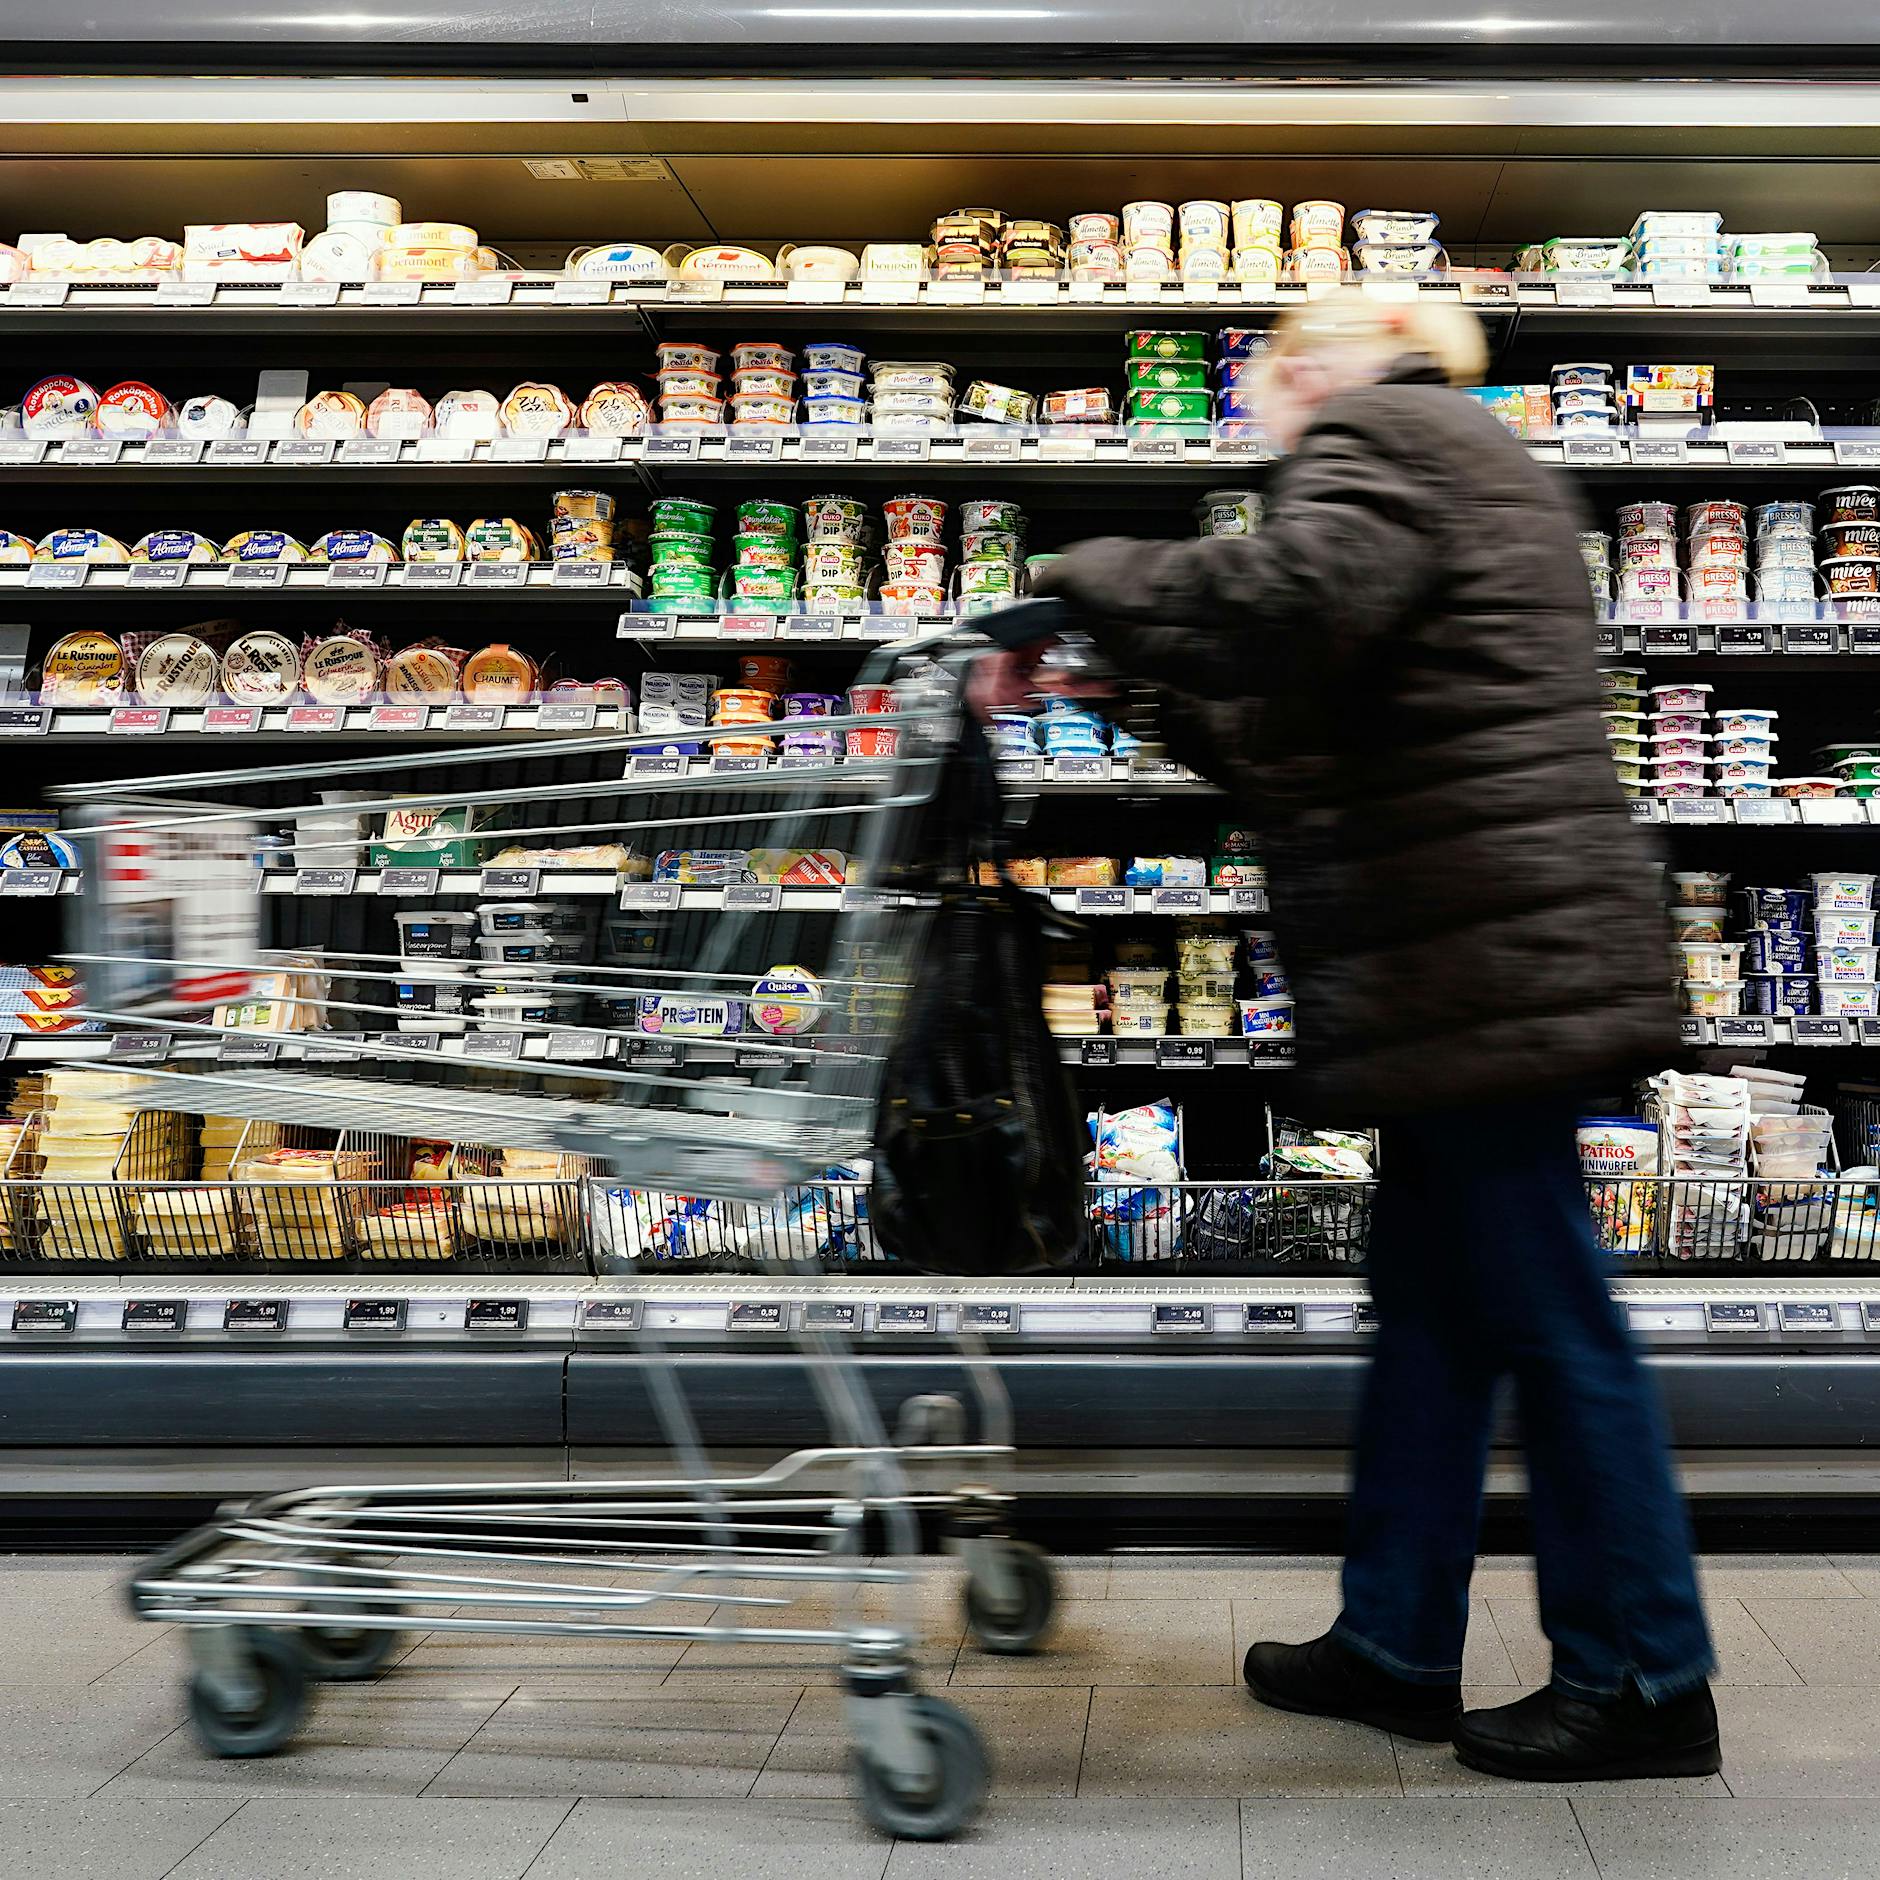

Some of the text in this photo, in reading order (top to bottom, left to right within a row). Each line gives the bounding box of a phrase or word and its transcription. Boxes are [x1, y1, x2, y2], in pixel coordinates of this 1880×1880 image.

[1384, 220, 1415, 231] Brunch
[1382, 249, 1414, 260] Brunch
[871, 259, 918, 271] boursin
[27, 379, 74, 413] Rotkäppchen
[107, 386, 158, 415] Rotkäppchen
[1835, 492, 1877, 508] miree
[1709, 511, 1740, 521] BRESSO
[1769, 511, 1800, 520] BRESSO
[823, 527, 840, 535] DIP
[912, 527, 930, 535] DIP
[55, 538, 97, 555] Almzeit
[151, 540, 192, 556] Almzeit
[242, 540, 282, 556] Almzeit
[330, 540, 370, 556] Almzeit
[1628, 543, 1659, 553] BRESSO
[1711, 542, 1741, 551] BRESSO
[1780, 542, 1809, 552] BRESSO
[821, 569, 838, 577] DIP
[890, 571, 903, 580] DIP
[1830, 563, 1873, 580] miree
[1639, 573, 1670, 583] BRESSO
[1704, 573, 1735, 583] BRESSO
[1672, 633, 1687, 641] 1,79
[1746, 633, 1762, 641] 1,79
[1812, 633, 1828, 641] 1,79
[239, 640, 252, 652] LE
[57, 651, 118, 662] LE RUSTIQUE
[314, 651, 364, 669] LE RUSTIQUE
[157, 640, 203, 692] RUSTIQUE
[472, 671, 520, 685] CHAUMES
[874, 743, 894, 756] XXL
[699, 851, 729, 859] Harzer-
[373, 856, 391, 867] Agur
[439, 856, 456, 867] Agur
[799, 862, 819, 882] MINIS
[767, 982, 798, 991] Quäse
[1187, 1046, 1203, 1054] 0,99
[47, 1307, 64, 1316] 1,99
[157, 1307, 174, 1316] 1,99
[258, 1307, 276, 1316] 1,99
[379, 1306, 396, 1315] 1,99
[499, 1306, 517, 1315] 1,99
[613, 1307, 632, 1315] 0,59
[760, 1308, 778, 1317] 0,59
[835, 1309, 852, 1317] 2,19
[908, 1309, 925, 1318] 2,29
[1184, 1309, 1202, 1318] 2,49
[1276, 1309, 1293, 1318] 1,79
[1738, 1308, 1756, 1317] 2,29
[1811, 1308, 1829, 1317] 2,29
